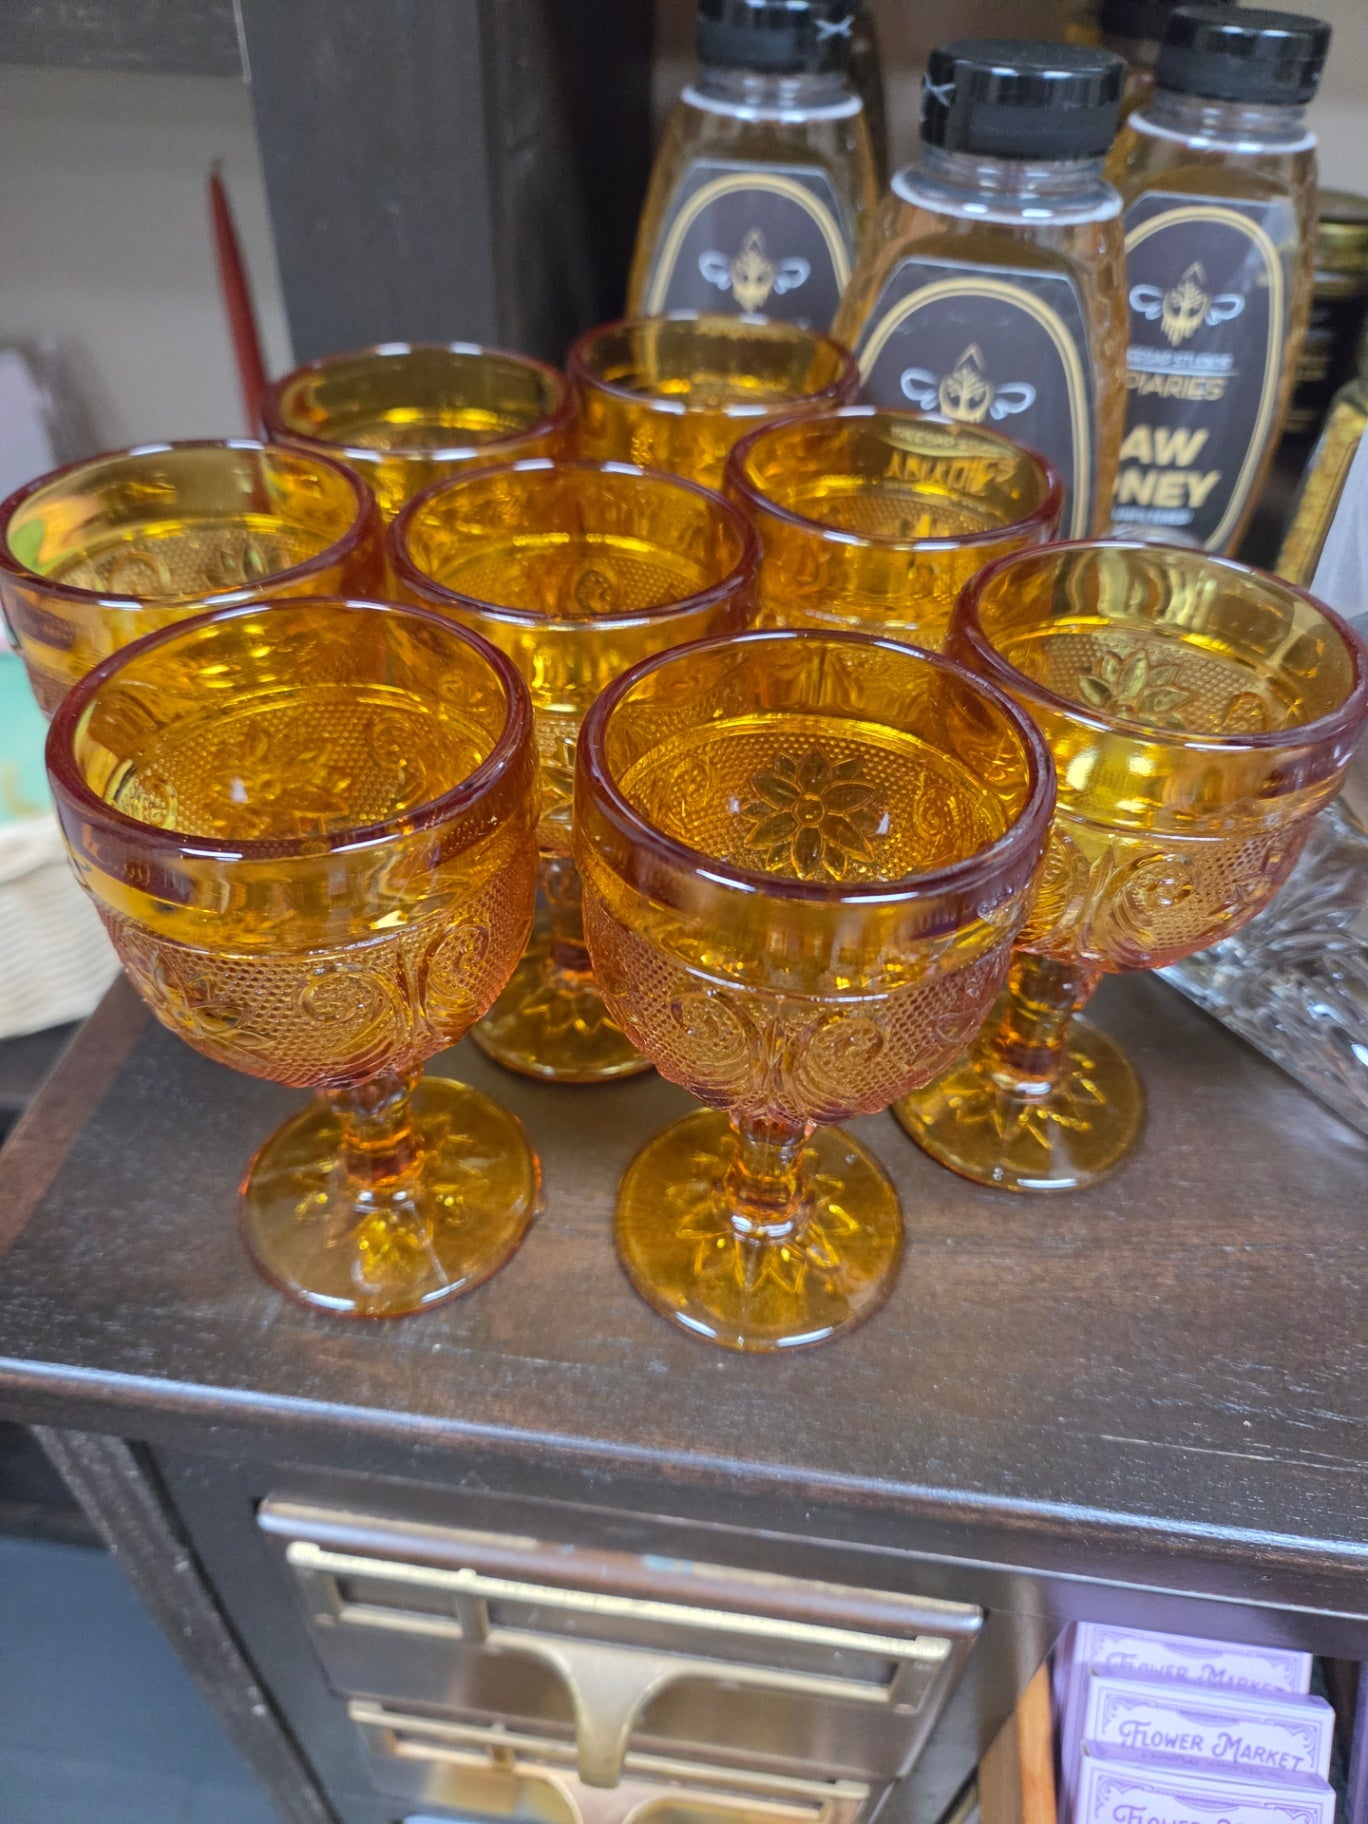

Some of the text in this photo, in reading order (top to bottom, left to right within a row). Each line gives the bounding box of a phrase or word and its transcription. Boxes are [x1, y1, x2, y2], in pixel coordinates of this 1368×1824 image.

[1126, 372, 1228, 401] PIARIES
[1119, 423, 1209, 467] AW
[1113, 466, 1222, 508] NEY
[1118, 1719, 1204, 1753] FLOWER
[1212, 1732, 1305, 1773] MARKET
